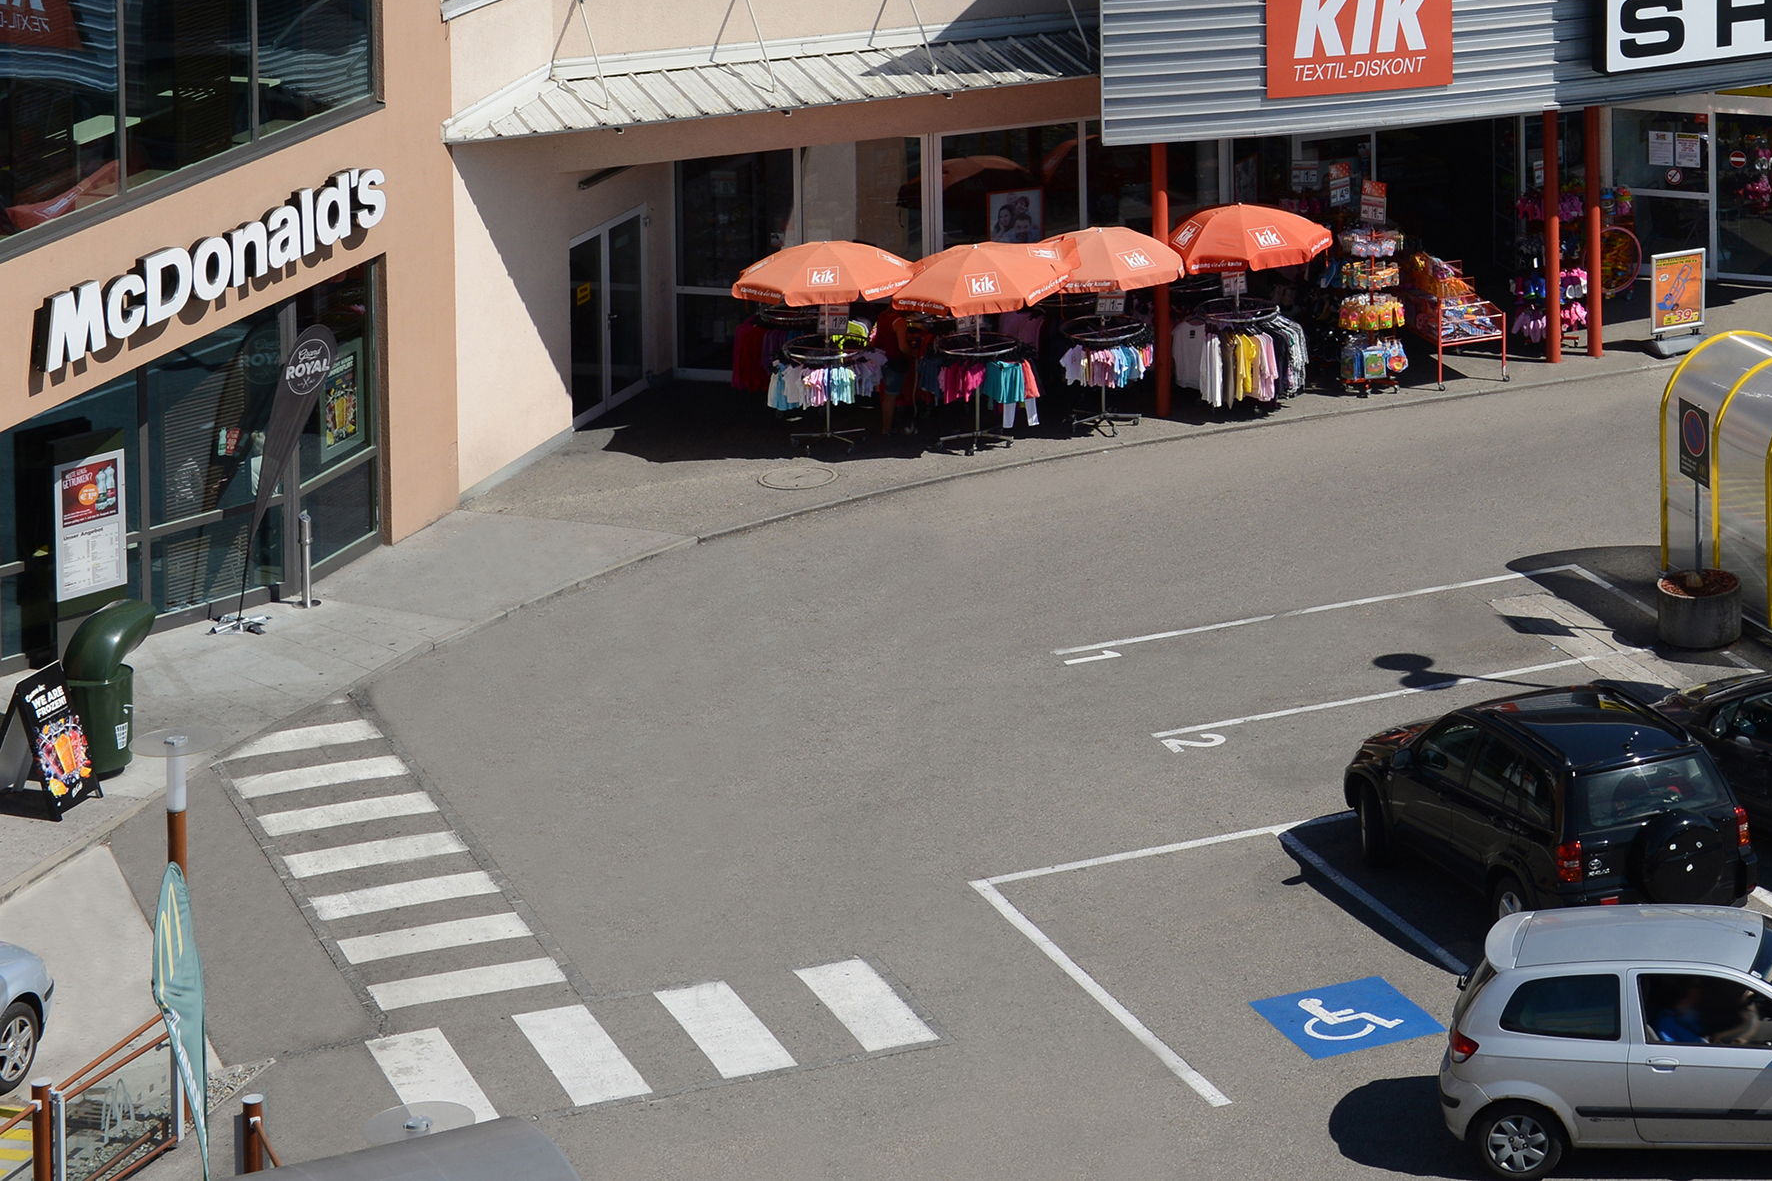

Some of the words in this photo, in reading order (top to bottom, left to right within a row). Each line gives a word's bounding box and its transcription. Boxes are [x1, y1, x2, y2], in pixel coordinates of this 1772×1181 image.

[1293, 56, 1427, 82] TEXTIL-DISKONT
[1256, 227, 1279, 246] kik
[1124, 250, 1148, 267] kik
[45, 167, 387, 373] McDonald's
[811, 268, 836, 284] kik
[971, 275, 996, 294] kik
[298, 346, 322, 363] Grand
[285, 358, 331, 380] ROYAL
[62, 472, 93, 490] GETRUNKEN?
[63, 533, 80, 542] Unser
[80, 526, 104, 537] Angebot
[31, 694, 48, 710] WE
[47, 685, 65, 701] ARE
[35, 696, 68, 719] FROZEN!
